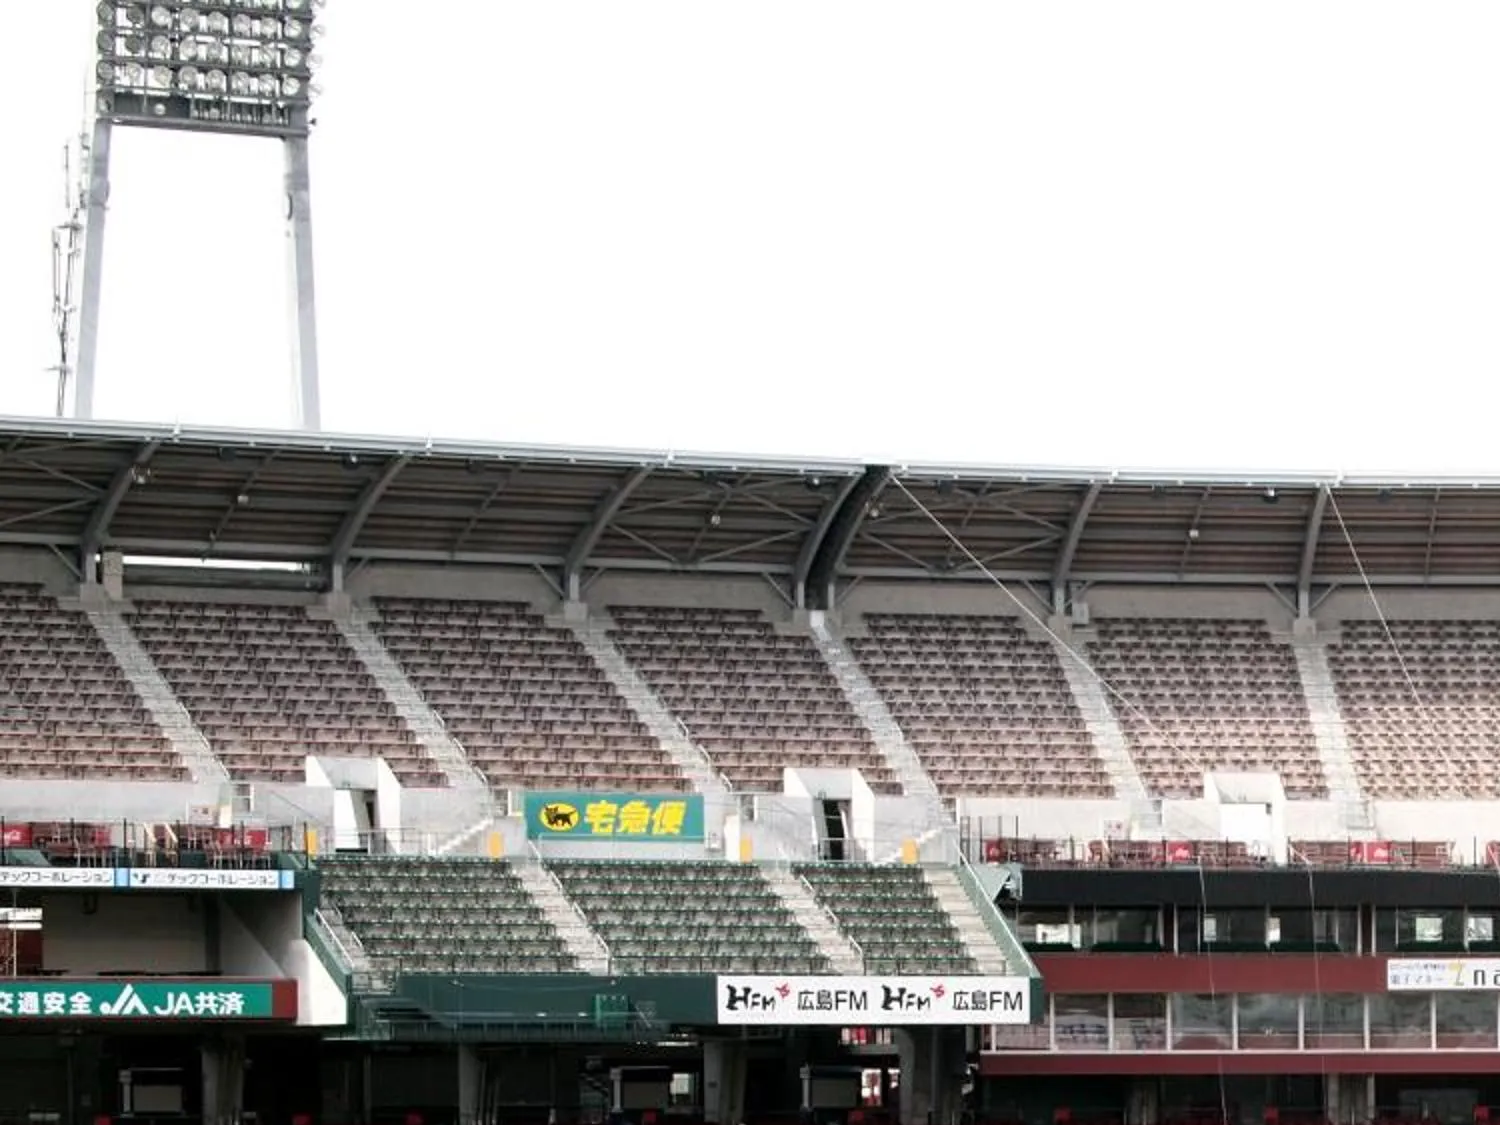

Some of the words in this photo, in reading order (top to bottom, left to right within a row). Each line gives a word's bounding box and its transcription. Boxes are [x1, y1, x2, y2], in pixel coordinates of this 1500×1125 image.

[584, 800, 687, 835] 宅急便
[154, 991, 245, 1015] JA共済
[797, 990, 868, 1012] 広島FM
[952, 990, 1024, 1012] 広島FM
